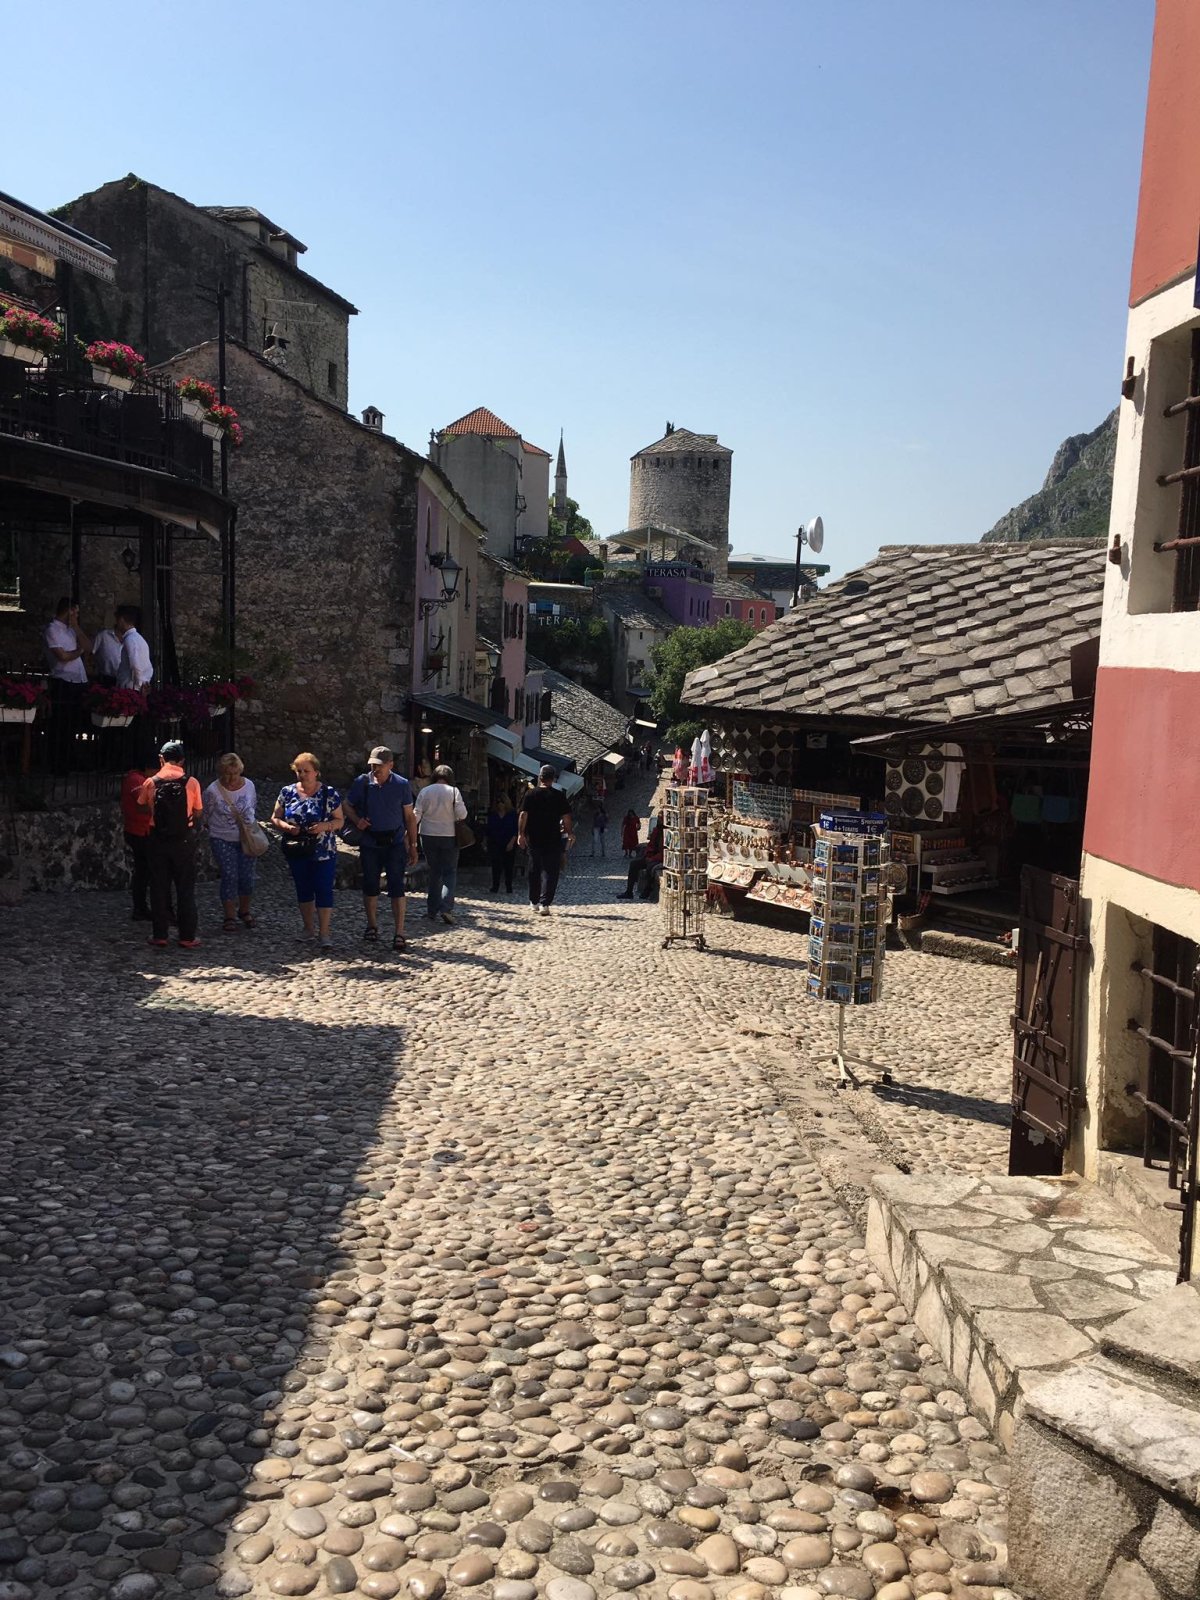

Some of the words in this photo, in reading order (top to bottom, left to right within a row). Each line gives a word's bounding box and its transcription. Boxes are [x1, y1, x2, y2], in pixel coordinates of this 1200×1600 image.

[647, 568, 686, 577] TERASA
[823, 820, 830, 829] 1€
[866, 825, 878, 833] 1€
